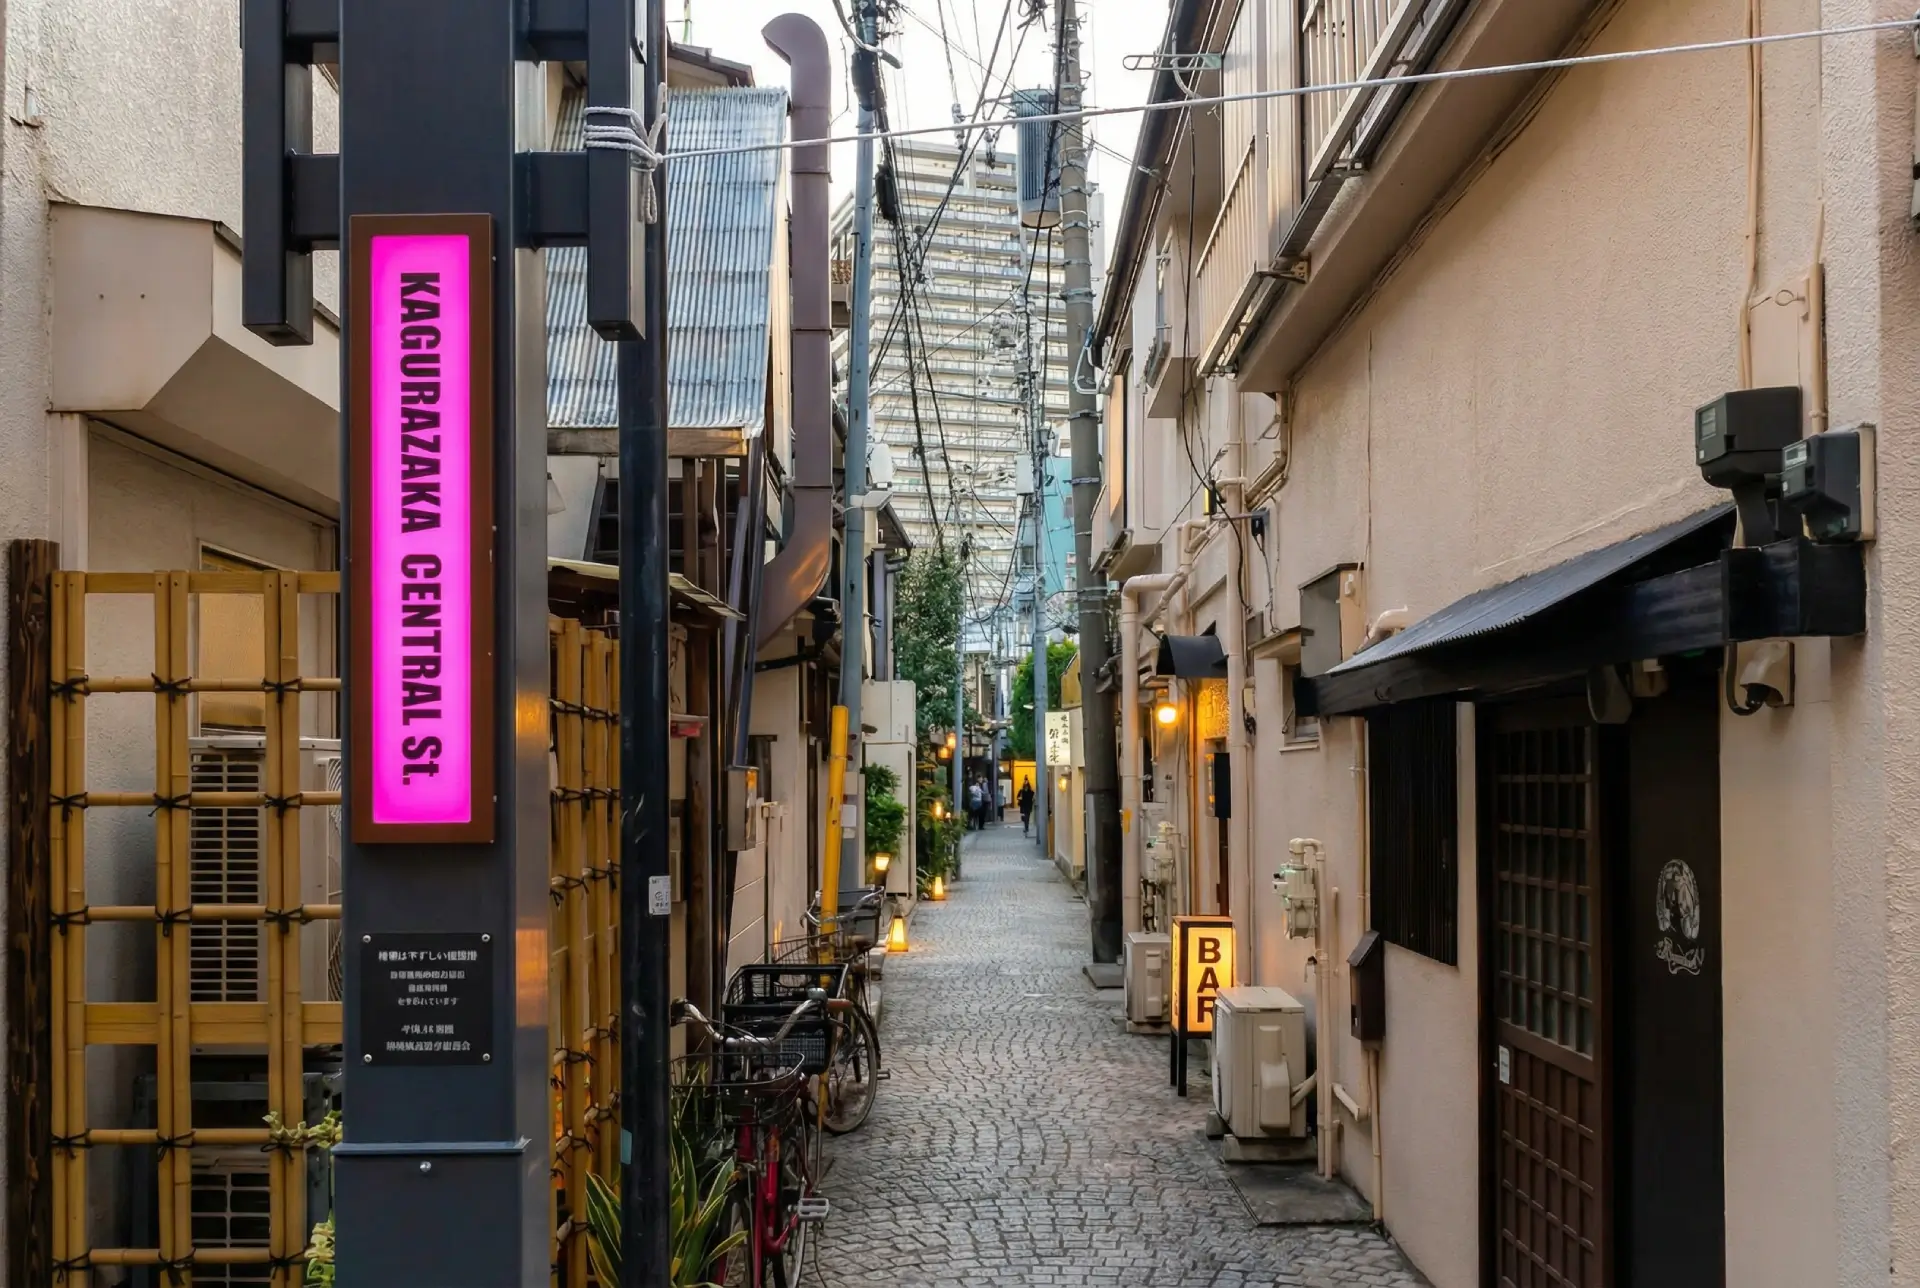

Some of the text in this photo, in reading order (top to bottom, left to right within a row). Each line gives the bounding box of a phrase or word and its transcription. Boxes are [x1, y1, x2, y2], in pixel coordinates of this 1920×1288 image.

[400, 272, 443, 786] KAGURAZAKA CENTRAL St.
